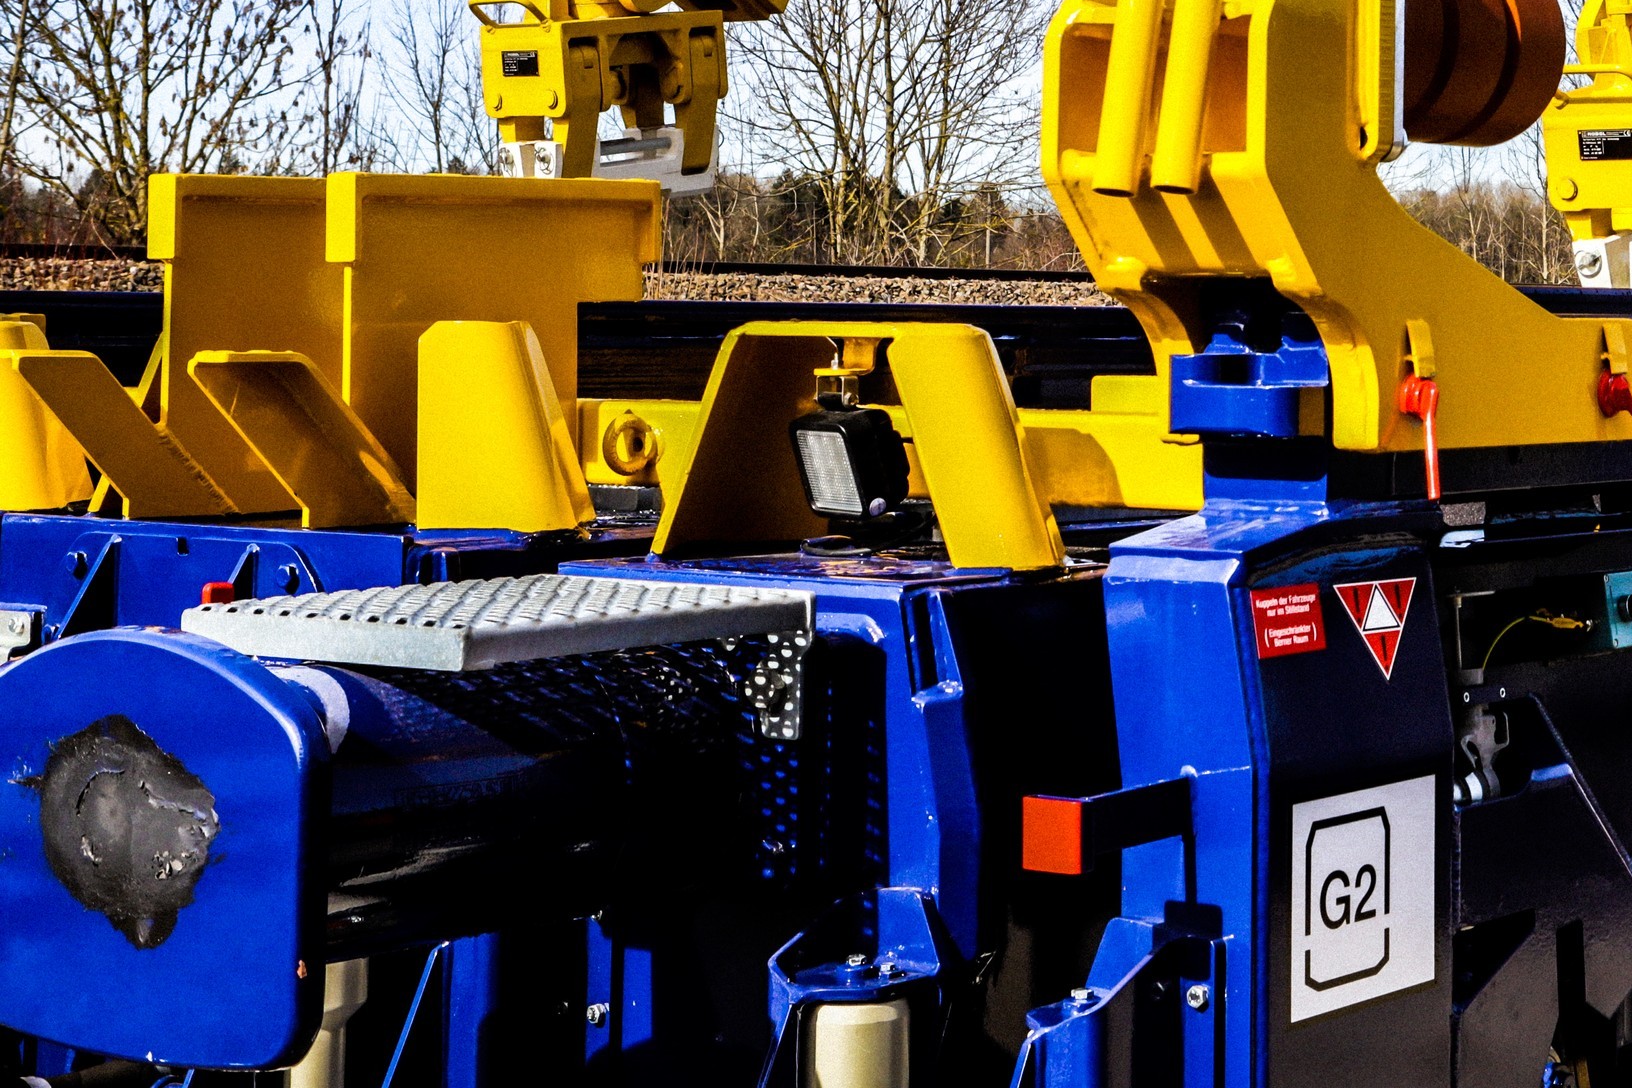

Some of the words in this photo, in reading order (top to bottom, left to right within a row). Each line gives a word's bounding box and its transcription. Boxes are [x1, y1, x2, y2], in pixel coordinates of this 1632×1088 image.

[1255, 598, 1278, 609] Kuppeln
[1278, 597, 1288, 605] der
[1288, 594, 1316, 603] Fahrzeuge
[1266, 609, 1276, 617] nur
[1276, 607, 1284, 615] im
[1285, 603, 1310, 614] Stillstand
[1319, 863, 1377, 930] G2
